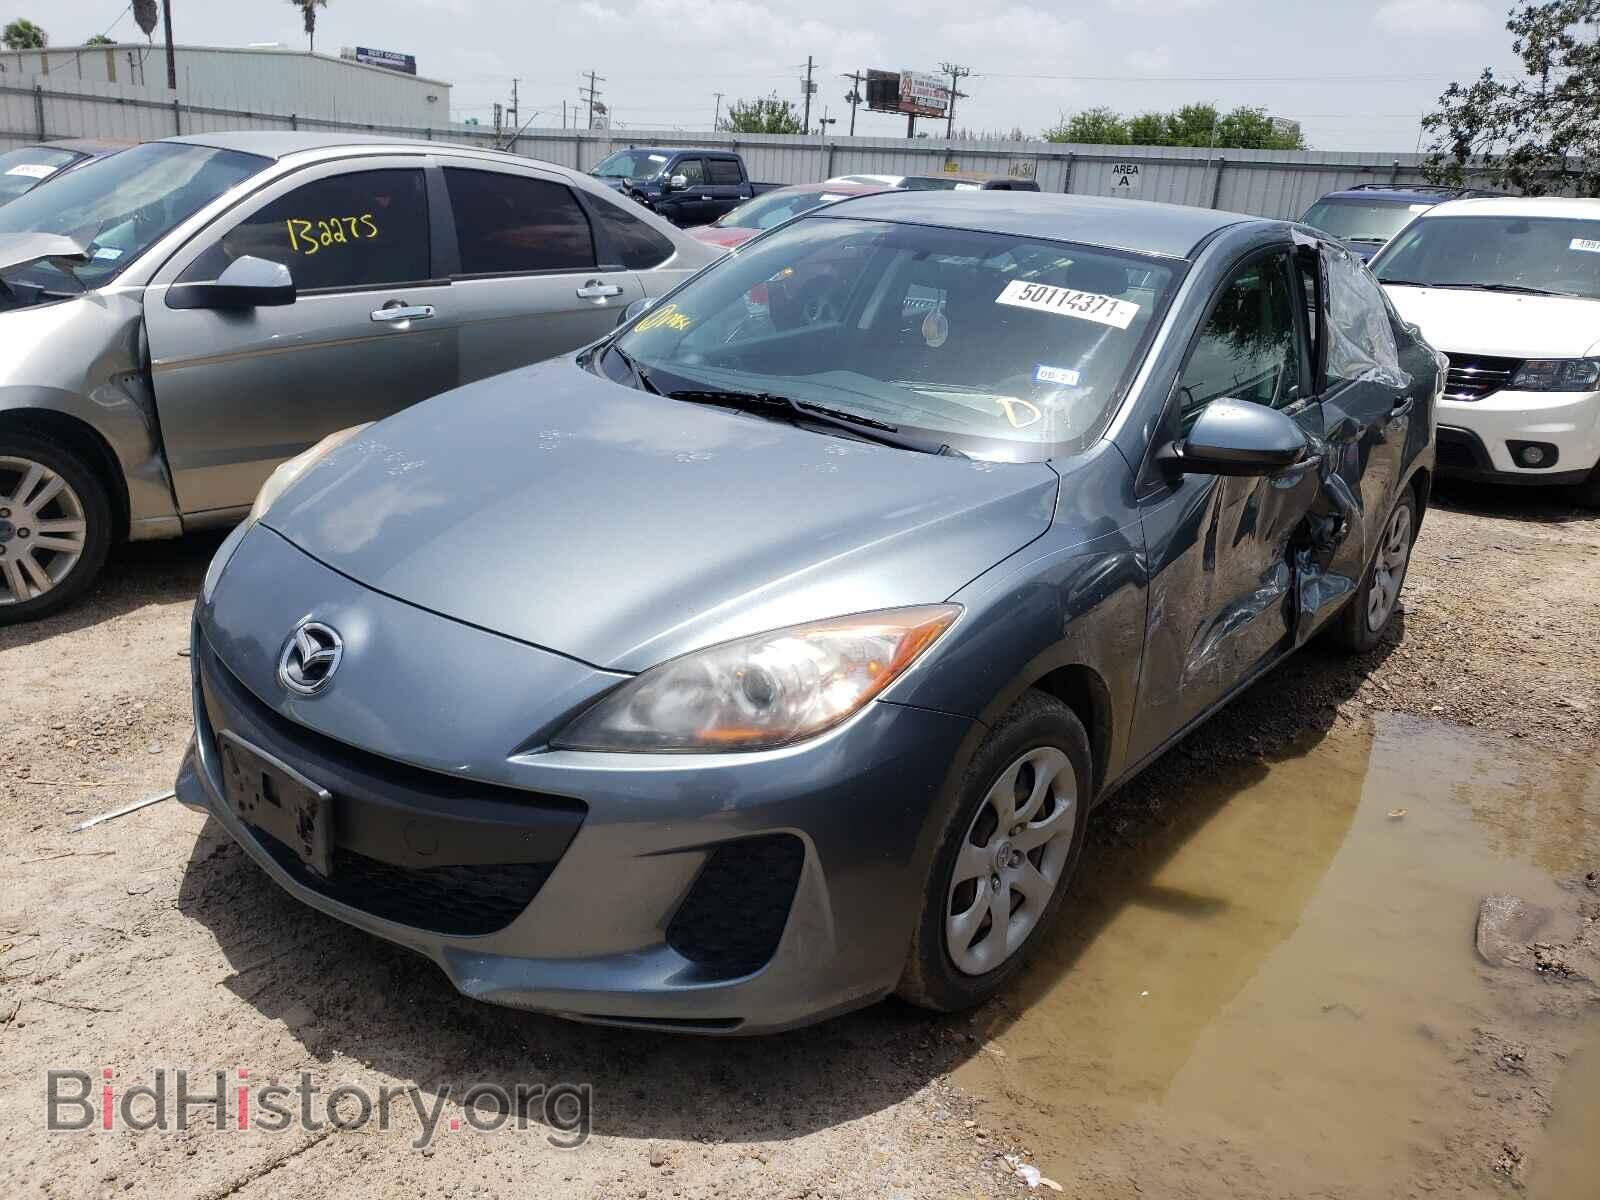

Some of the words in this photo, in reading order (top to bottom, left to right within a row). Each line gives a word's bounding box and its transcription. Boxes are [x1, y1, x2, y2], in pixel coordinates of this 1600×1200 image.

[1113, 164, 1139, 175] AREA
[1119, 176, 1130, 186] A
[1018, 284, 1119, 318] 50114371
[995, 395, 1042, 428] D
